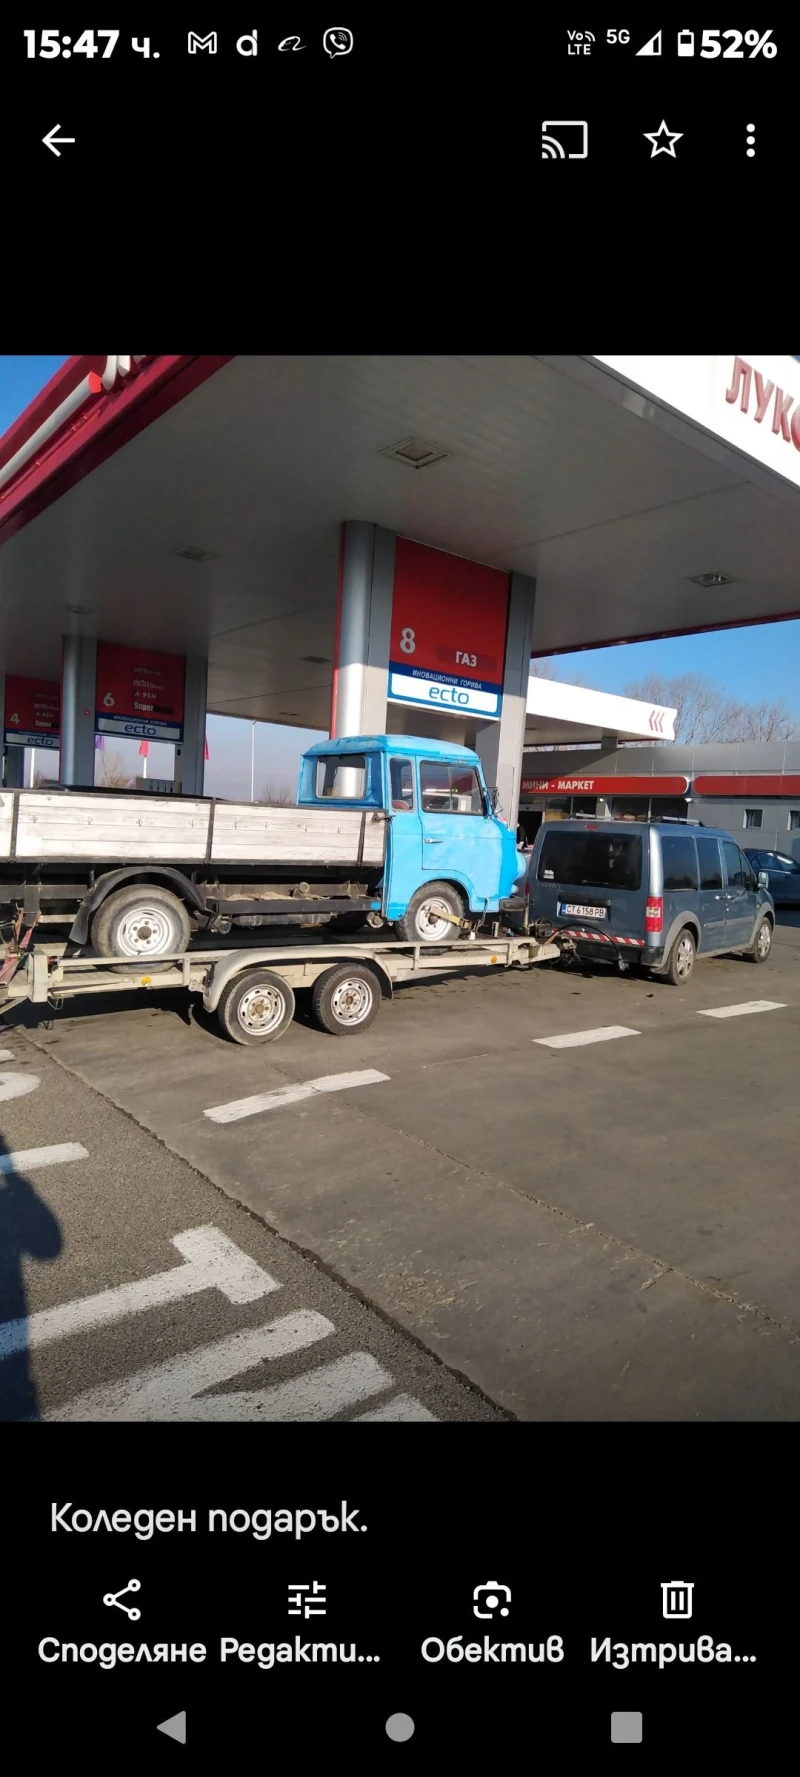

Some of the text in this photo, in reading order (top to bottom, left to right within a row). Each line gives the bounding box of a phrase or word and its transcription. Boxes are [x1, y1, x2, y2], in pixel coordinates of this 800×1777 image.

[400, 628, 416, 654] 8
[455, 651, 477, 667] ГАЗ
[412, 669, 482, 690] ИНОВАЦИОННИ ГОРИВА
[103, 692, 115, 707] 6
[429, 686, 470, 705] ecto
[134, 701, 154, 712] Super
[10, 712, 20, 725] 4
[124, 724, 156, 736] ecto
[27, 737, 53, 746] ecto
[522, 780, 549, 790] МИНИ
[557, 780, 595, 790] МАРКЕТ
[566, 905, 605, 918] CT 6158 PB
